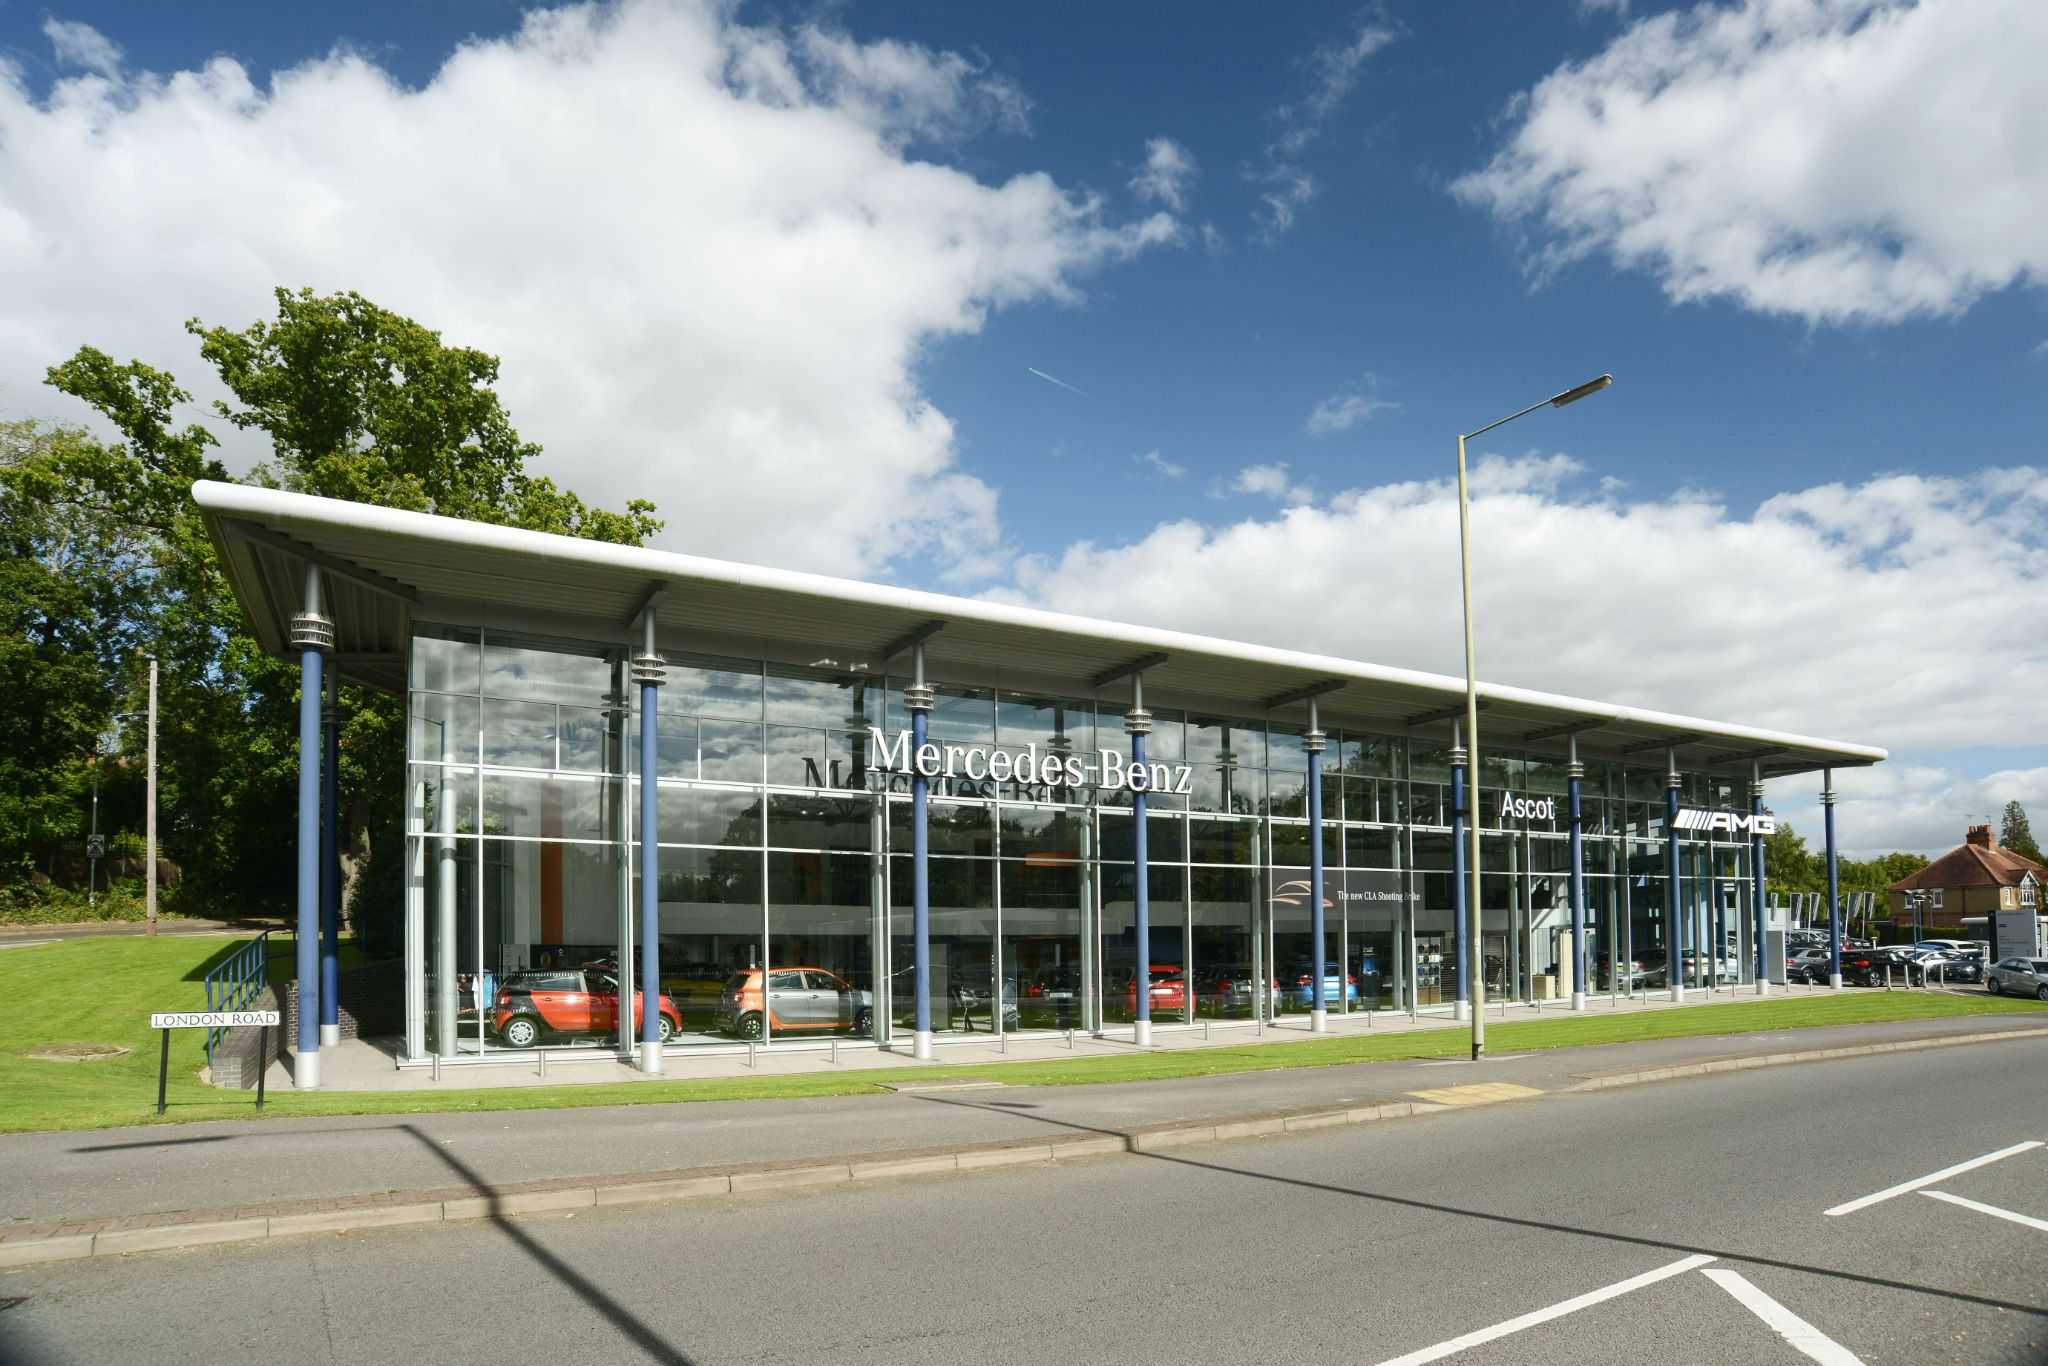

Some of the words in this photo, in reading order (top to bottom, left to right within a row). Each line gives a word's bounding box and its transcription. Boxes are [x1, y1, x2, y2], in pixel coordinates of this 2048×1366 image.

[866, 726, 1193, 794] Mercedes-Benz
[1501, 791, 1555, 820] Ascot
[1707, 811, 1775, 834] AMG
[1337, 890, 1349, 900] The
[1350, 892, 1363, 900] new
[1364, 890, 1377, 900] CLA
[1377, 891, 1404, 903] Shooting
[154, 1014, 225, 1027] LONDON
[232, 1013, 277, 1025] ROAD
